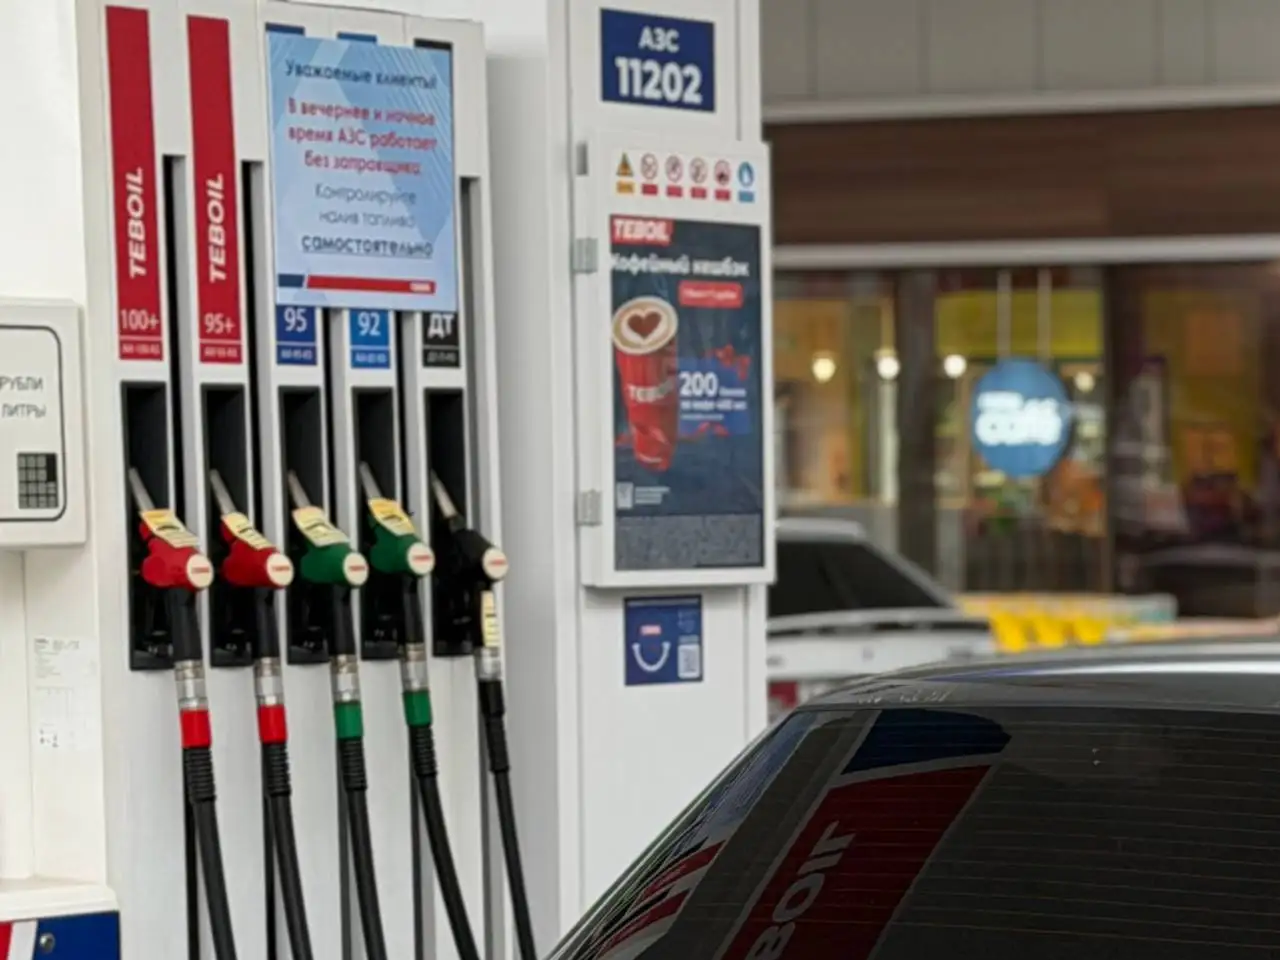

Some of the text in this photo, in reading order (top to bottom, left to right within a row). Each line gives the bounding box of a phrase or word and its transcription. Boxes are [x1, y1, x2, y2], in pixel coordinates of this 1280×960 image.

[639, 25, 680, 53] АЗС
[285, 60, 371, 84] Уважаемые
[614, 56, 703, 105] 11202
[301, 101, 370, 121] вечернее
[288, 127, 437, 151] время АЗС работает
[304, 150, 329, 168] без
[126, 167, 147, 279] TEBOIL
[205, 173, 227, 284] TEBOIL
[301, 235, 433, 257] самостоятельно
[120, 309, 159, 331] 100+
[204, 312, 235, 334] 95+
[284, 307, 307, 333] 95
[357, 312, 381, 337] 92
[427, 313, 455, 340] ДТ
[0, 376, 43, 392] РУБЛИ
[679, 371, 719, 398] 200
[2, 403, 46, 418] ЛИТРЫ
